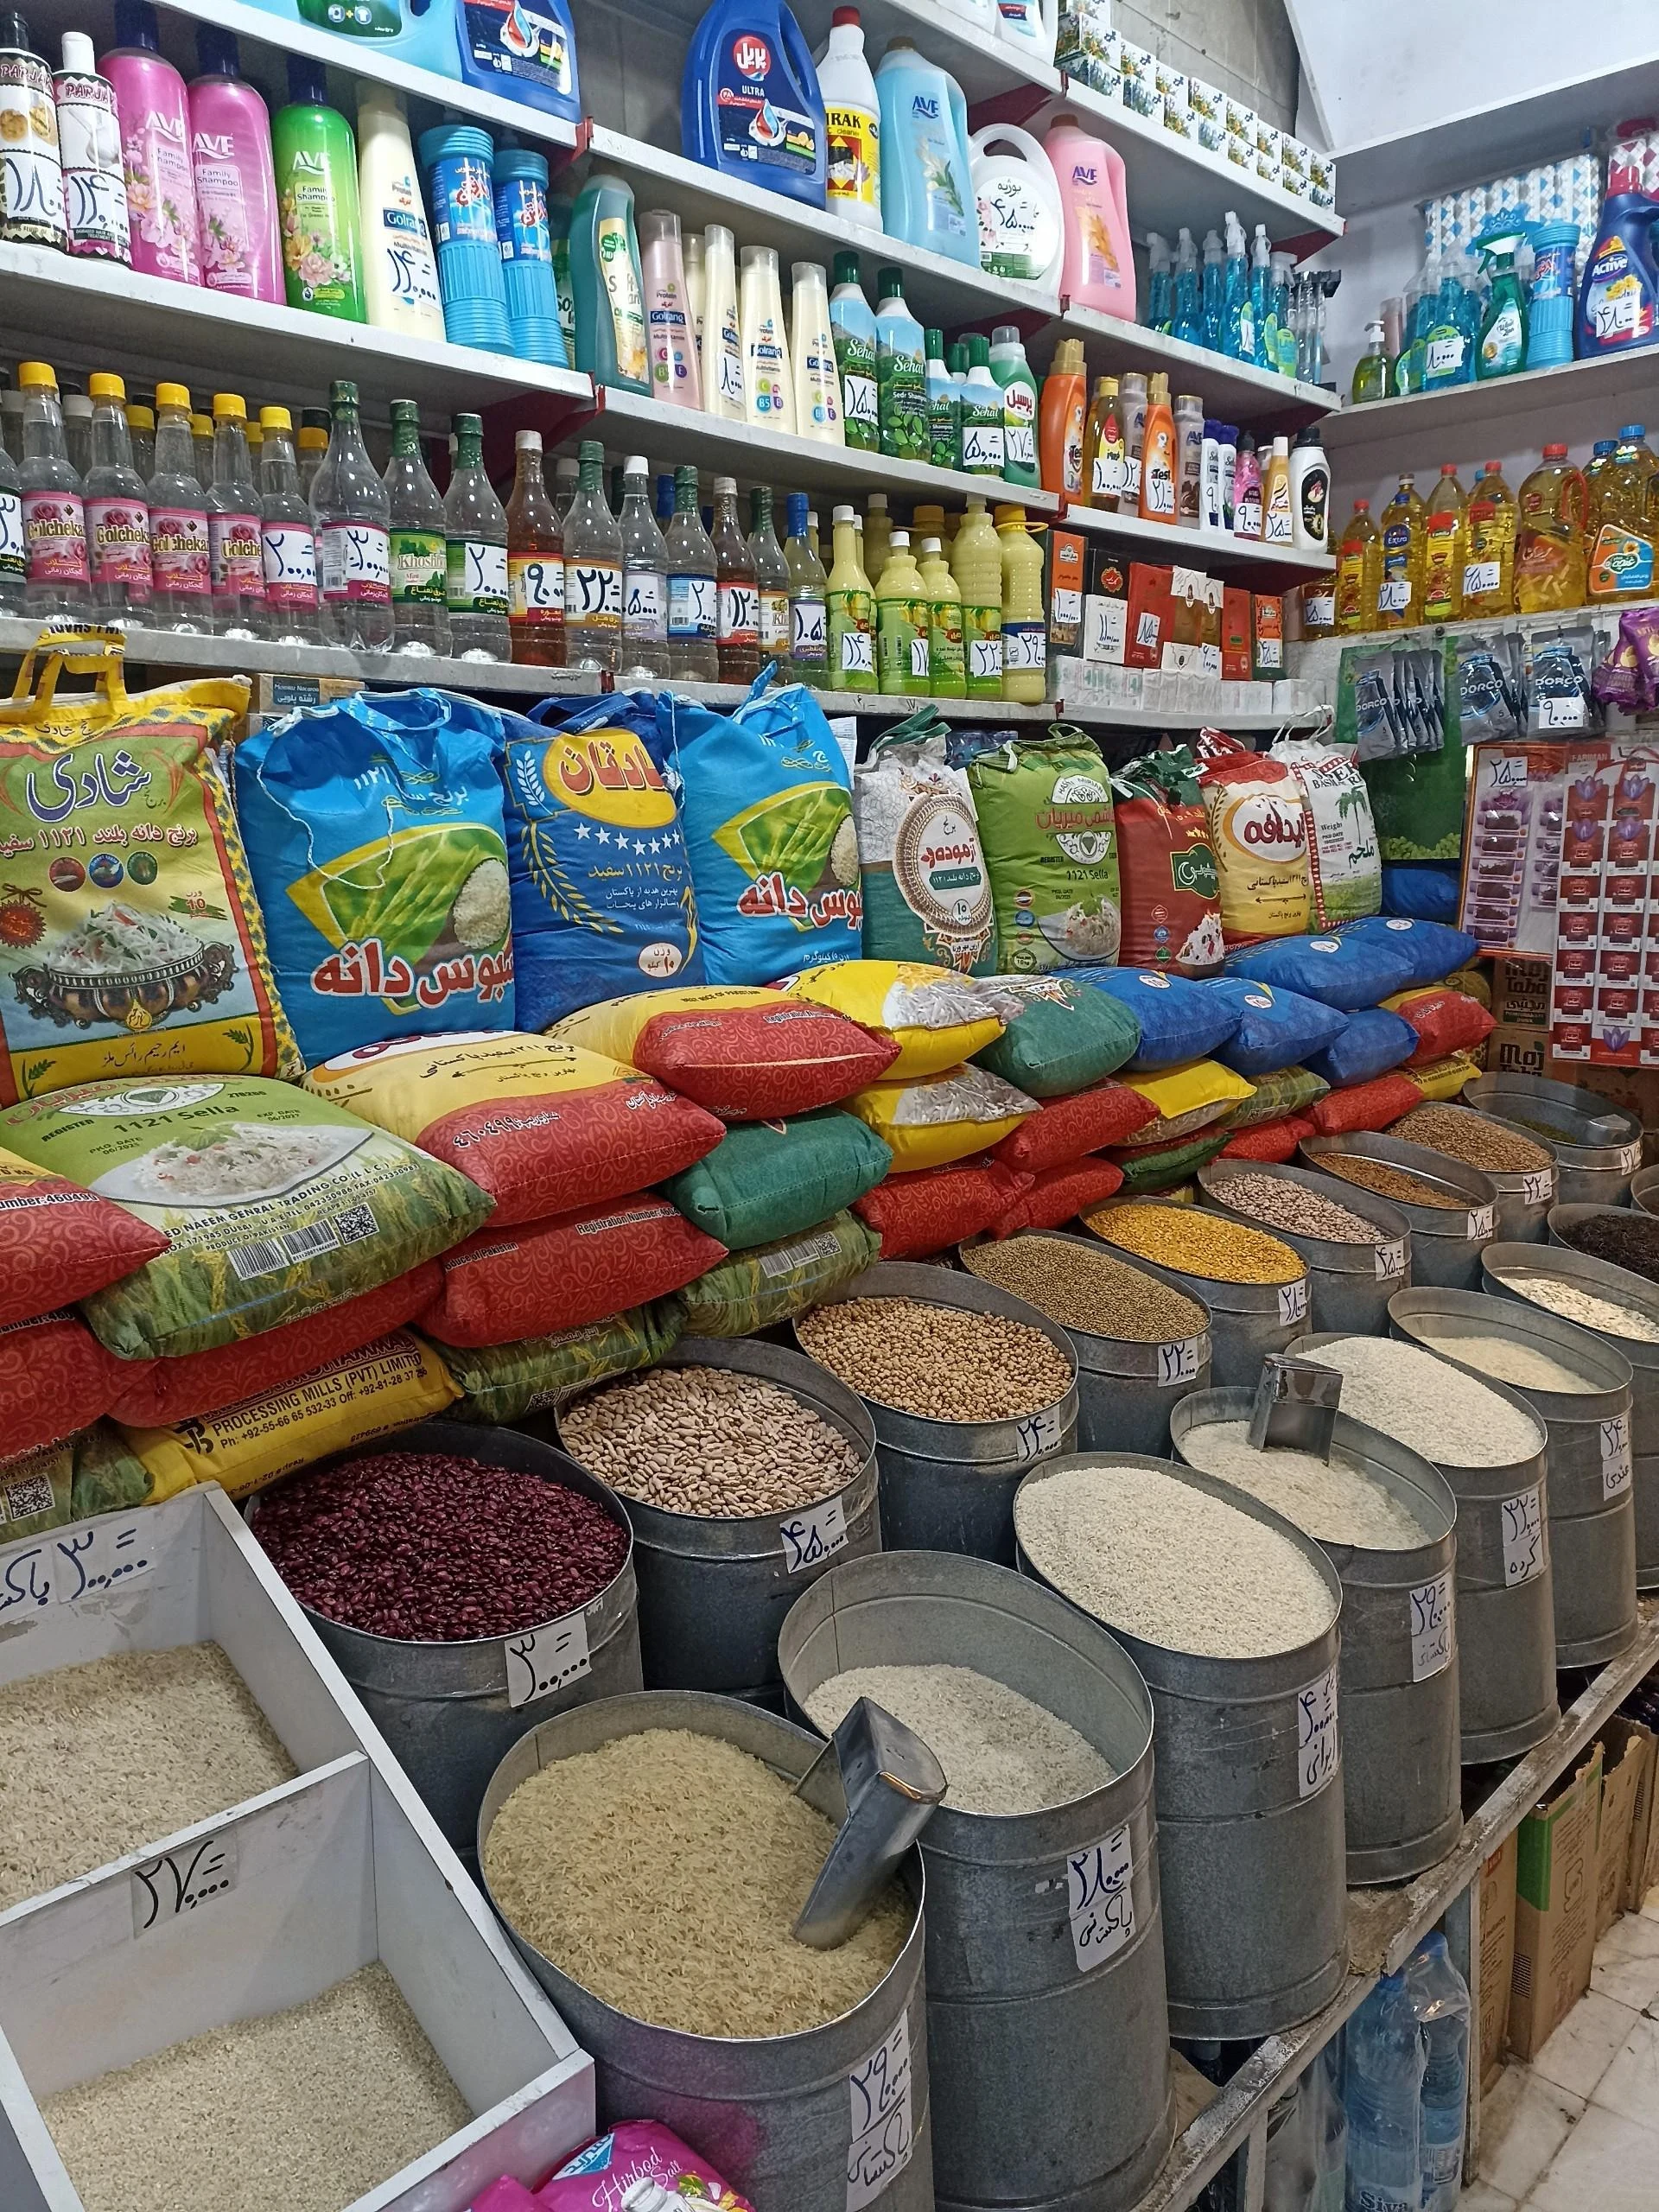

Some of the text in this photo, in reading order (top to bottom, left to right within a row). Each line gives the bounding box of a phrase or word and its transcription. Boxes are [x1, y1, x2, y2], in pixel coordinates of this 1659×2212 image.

[741, 85, 766, 98] ULTRA
[912, 95, 939, 119] AVE
[192, 132, 235, 159] AVE
[201, 168, 232, 180] Family
[1072, 165, 1098, 186] AVE
[1592, 257, 1628, 277] Active
[651, 312, 684, 324] Golrang
[893, 354, 925, 374] Sehat
[929, 401, 950, 412] ehat
[972, 404, 999, 418] Sehat
[1388, 535, 1408, 545] Extra
[1459, 678, 1504, 696] DORCO
[1535, 675, 1584, 686] DORCO
[26, 749, 153, 823] شادی
[39, 826, 86, 849] ۱۱۲۱
[93, 825, 127, 846] بلند
[131, 822, 163, 843] دانه
[166, 825, 200, 846] برنج
[588, 863, 626, 885] سفید
[1066, 868, 1109, 881] 1121 Sella
[737, 872, 808, 918] دانه
[310, 938, 415, 996] دانه
[113, 1104, 241, 1135] 1121 Sella
[182, 1179, 331, 1234] NAEEM GENRAL TRADING
[223, 1222, 253, 1238] DUBAI
[576, 1215, 628, 1235] Registration
[205, 1238, 242, 1252] PRODUCE
[253, 1223, 291, 1238] PAKISTAN
[480, 1241, 519, 1259] Pakistan
[212, 1394, 301, 1437] PROCESSING
[302, 1377, 344, 1403] MILLS
[345, 1363, 379, 1392] (PVT)
[219, 1436, 241, 1450] Ph:
[241, 1415, 291, 1441] +92-55-66
[291, 1410, 306, 1422] 65
[306, 1397, 338, 1417] 532-33
[338, 1391, 357, 1404] Off:
[591, 2145, 664, 2212] Hirbod
[650, 2159, 683, 2190] Salt
